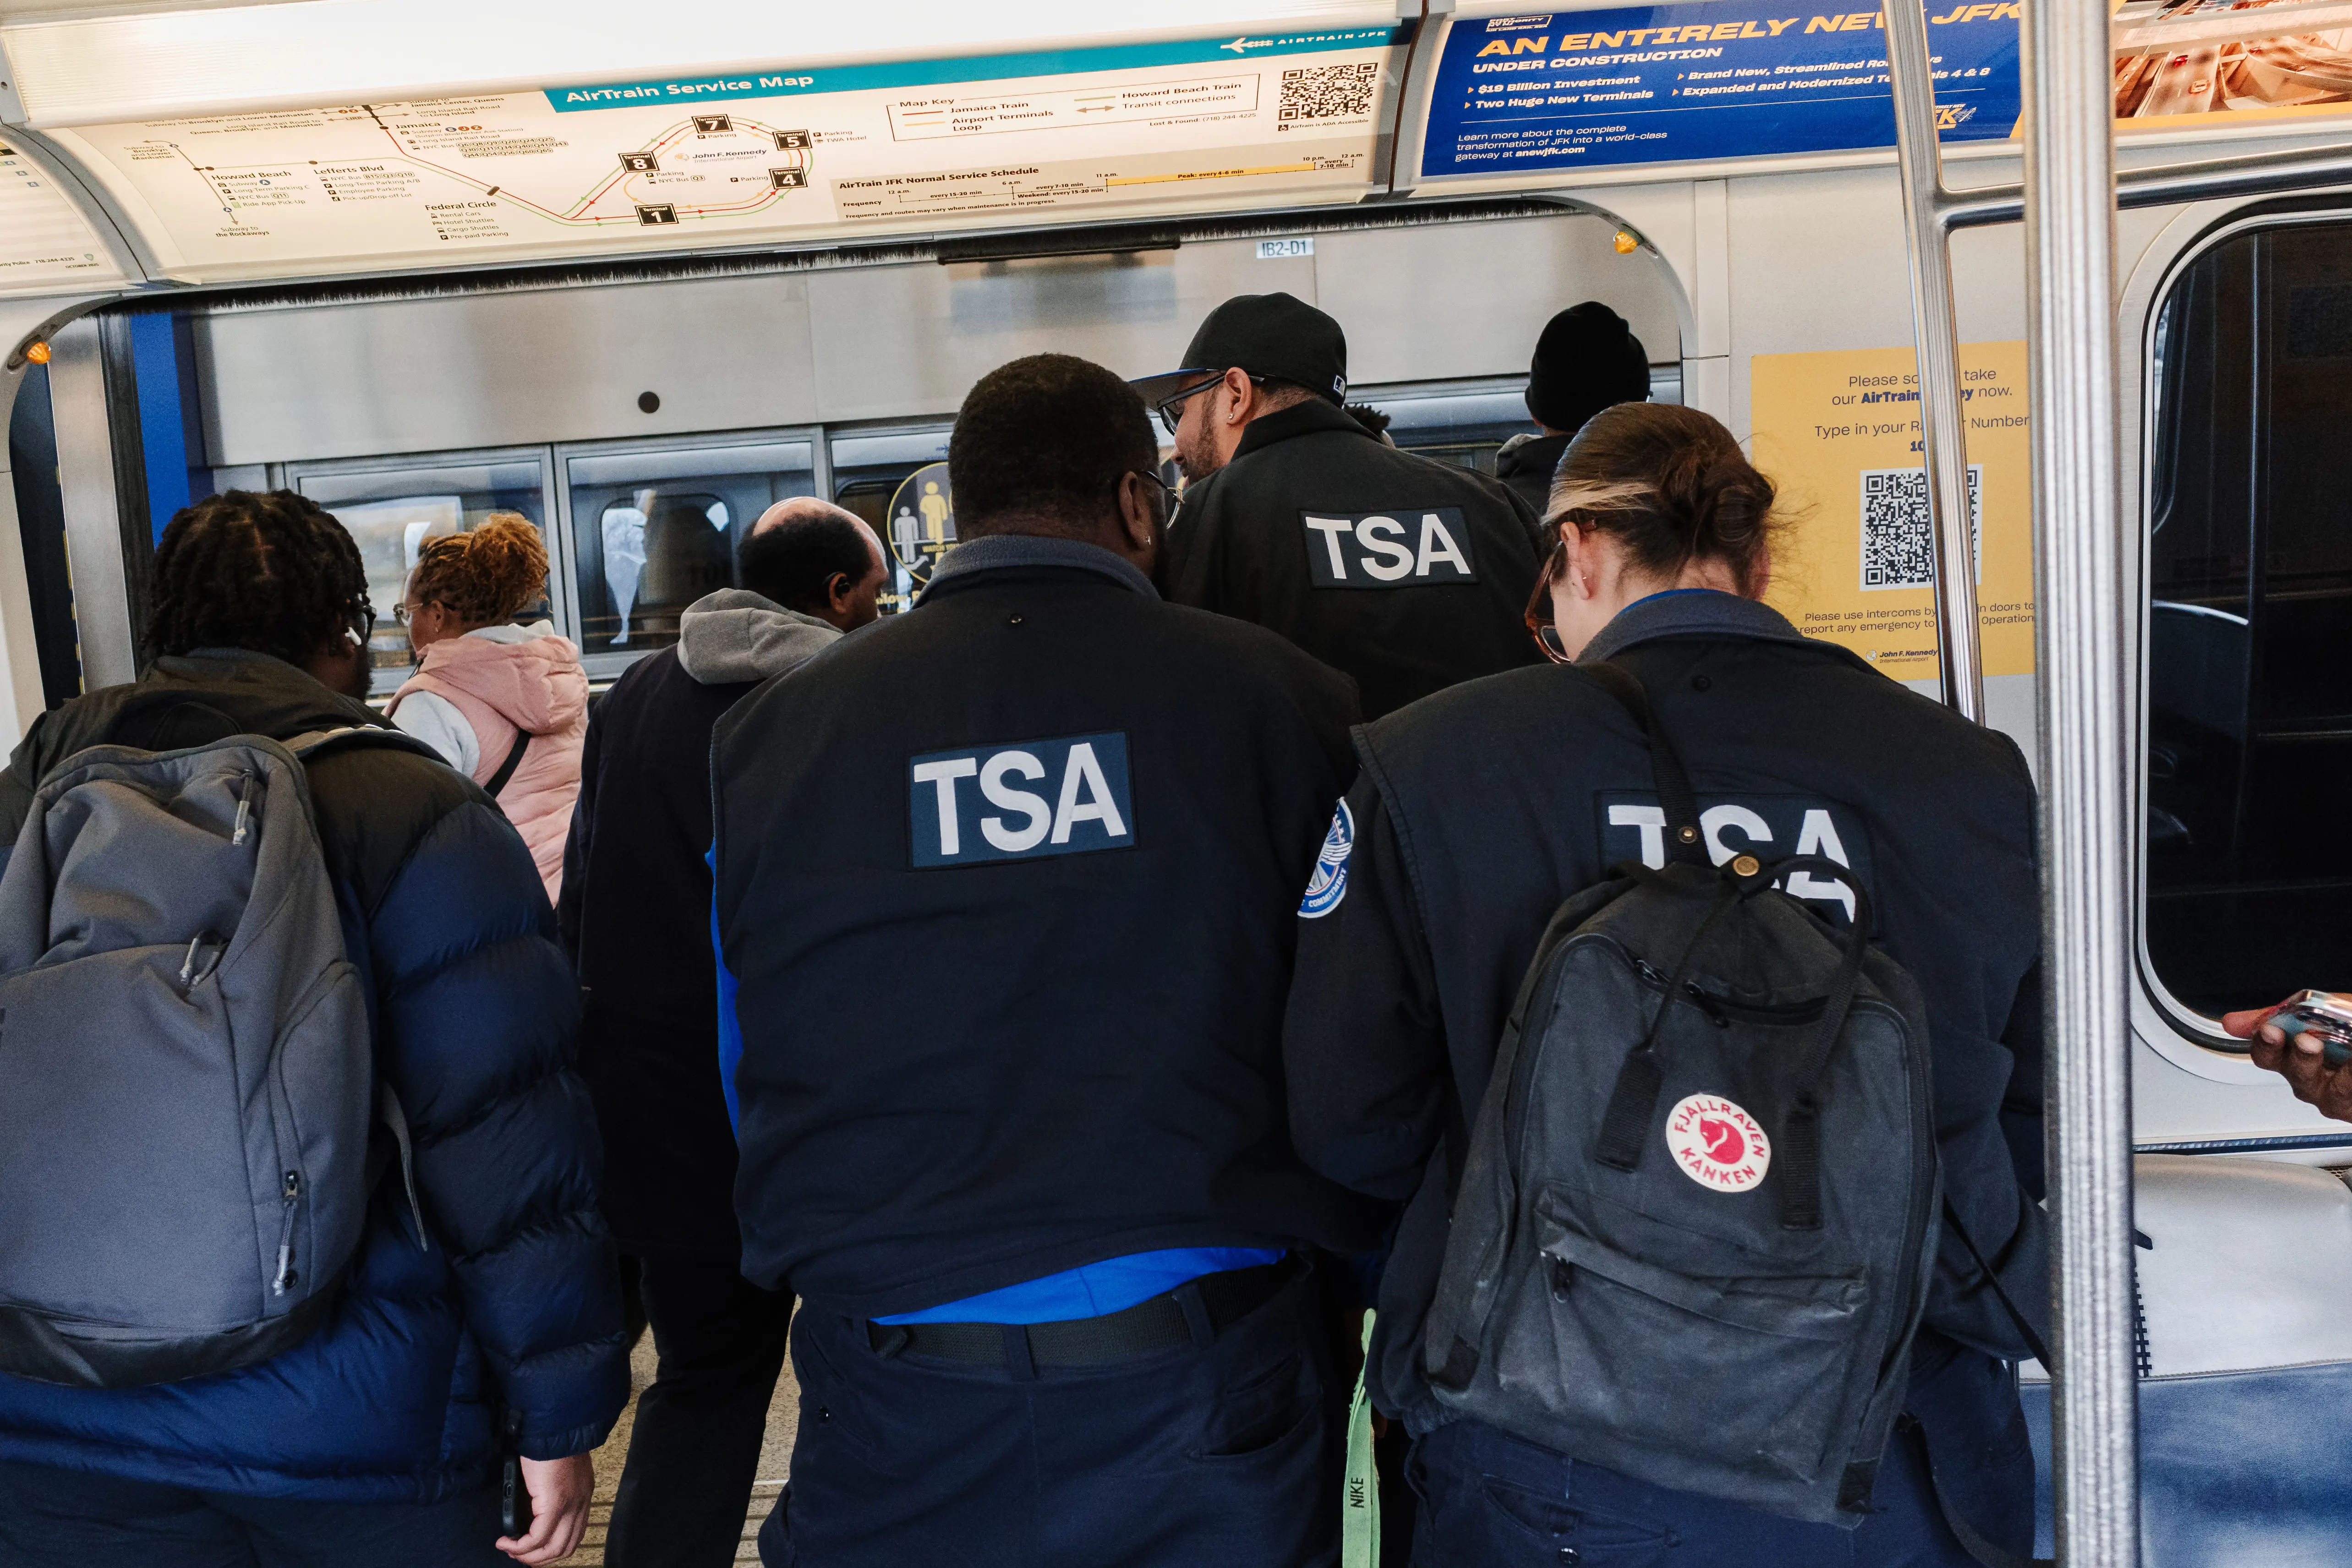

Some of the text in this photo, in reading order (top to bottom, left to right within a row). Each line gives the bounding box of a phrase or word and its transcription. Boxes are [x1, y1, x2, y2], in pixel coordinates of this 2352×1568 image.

[1476, 36, 1549, 57] AN
[1559, 17, 1800, 51] ENTIRELY
[1932, 2, 2021, 24] JFK
[1278, 34, 1354, 44] AIRTRAIN
[1472, 48, 1723, 73] UNDER CONSTRUCTION
[1688, 71, 1733, 80] Brand
[1734, 67, 1770, 77] New,
[1774, 60, 1864, 75] Streamlined
[566, 76, 813, 103] AirTrain Service Map
[1478, 76, 1641, 94] $19 Billion Investment
[1682, 84, 1756, 97] Expanded
[1757, 82, 1786, 91] and
[1788, 76, 1873, 89] Modernized
[1964, 68, 1977, 76] &
[1123, 89, 1169, 98] Howard
[1166, 94, 1236, 105] connections
[1476, 90, 1654, 109] Two Huge New Terminals
[951, 105, 996, 113] Jamaica
[952, 111, 1054, 125] Airport Terminals
[706, 120, 717, 131] 7
[1459, 133, 1488, 142] Learn
[1522, 129, 1553, 137] about
[1576, 125, 1626, 135] complete
[787, 137, 800, 147] 5
[1456, 140, 1535, 151] transformation
[1605, 131, 1667, 142] world-class
[1455, 152, 1499, 162] gateway
[1515, 146, 1585, 157] anewjfk.com
[633, 158, 647, 169] 8
[782, 174, 796, 186] 4
[839, 180, 882, 189] AirTrain
[906, 175, 946, 184] Normal
[991, 167, 1039, 176] Schedule
[651, 211, 662, 222] 1
[1849, 374, 1898, 387] Please
[1964, 369, 1996, 381] take
[1832, 395, 1857, 405] our
[1860, 391, 1920, 404] AirTrain
[1978, 387, 2013, 398] now.
[1815, 425, 1850, 440] Type
[1855, 423, 1868, 435] in
[1872, 423, 1906, 437] your
[1971, 415, 2029, 428] Number
[1305, 514, 1471, 581] TSA
[1805, 612, 1841, 621] Please
[1844, 612, 1863, 620] use
[1867, 608, 1921, 618] intercoms
[1924, 606, 1936, 617] by
[1990, 603, 2021, 612] doors
[1800, 624, 1834, 635] report
[1837, 624, 1857, 634] any
[1860, 622, 1920, 632] emergency
[1905, 649, 1937, 657] Kennedy
[914, 743, 1127, 855] TSA
[1680, 1147, 1757, 1184] KANKEN
[1351, 1477, 1364, 1508] NIKE
